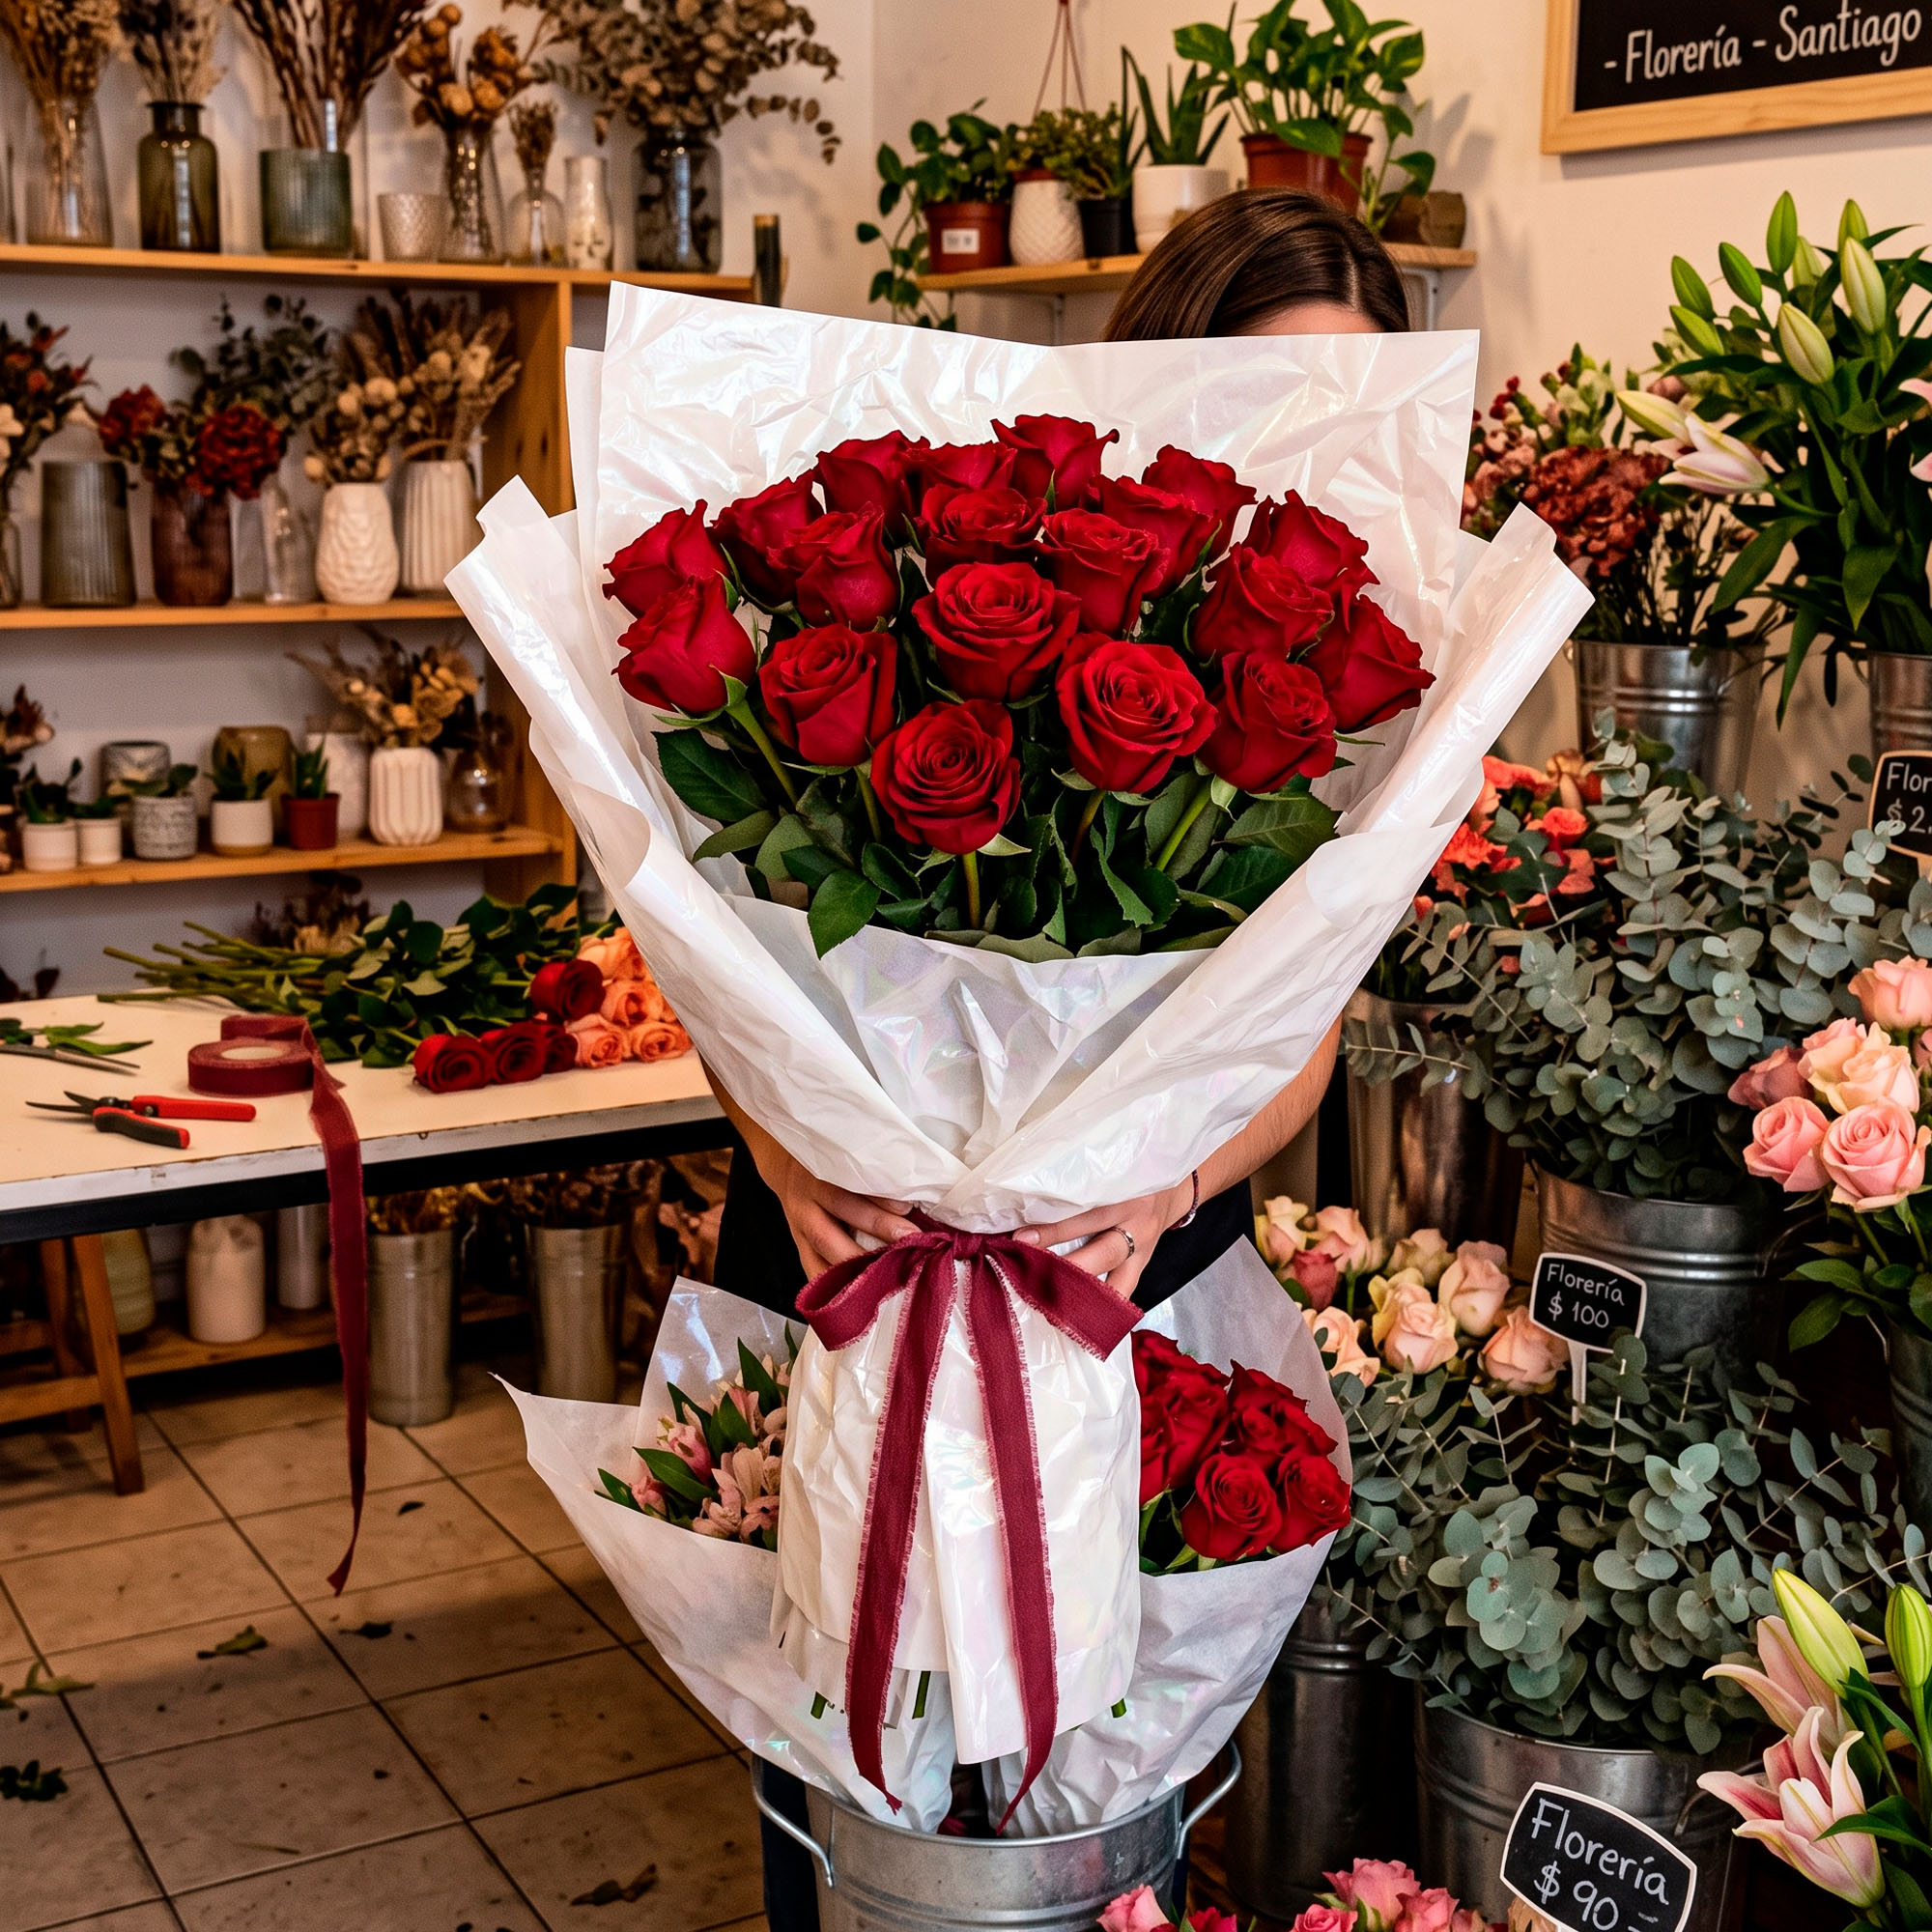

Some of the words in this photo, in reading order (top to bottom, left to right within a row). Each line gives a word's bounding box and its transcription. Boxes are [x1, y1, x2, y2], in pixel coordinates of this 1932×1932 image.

[1625, 24, 1742, 84] Florería
[1776, 0, 1922, 67] Santiago
[1547, 1263, 1625, 1307] Florería
[1548, 1290, 1564, 1322] $
[1572, 1300, 1610, 1329] 100
[1531, 1797, 1670, 1906] Florería
[1533, 1860, 1562, 1905] $
[1573, 1880, 1620, 1931] 90
